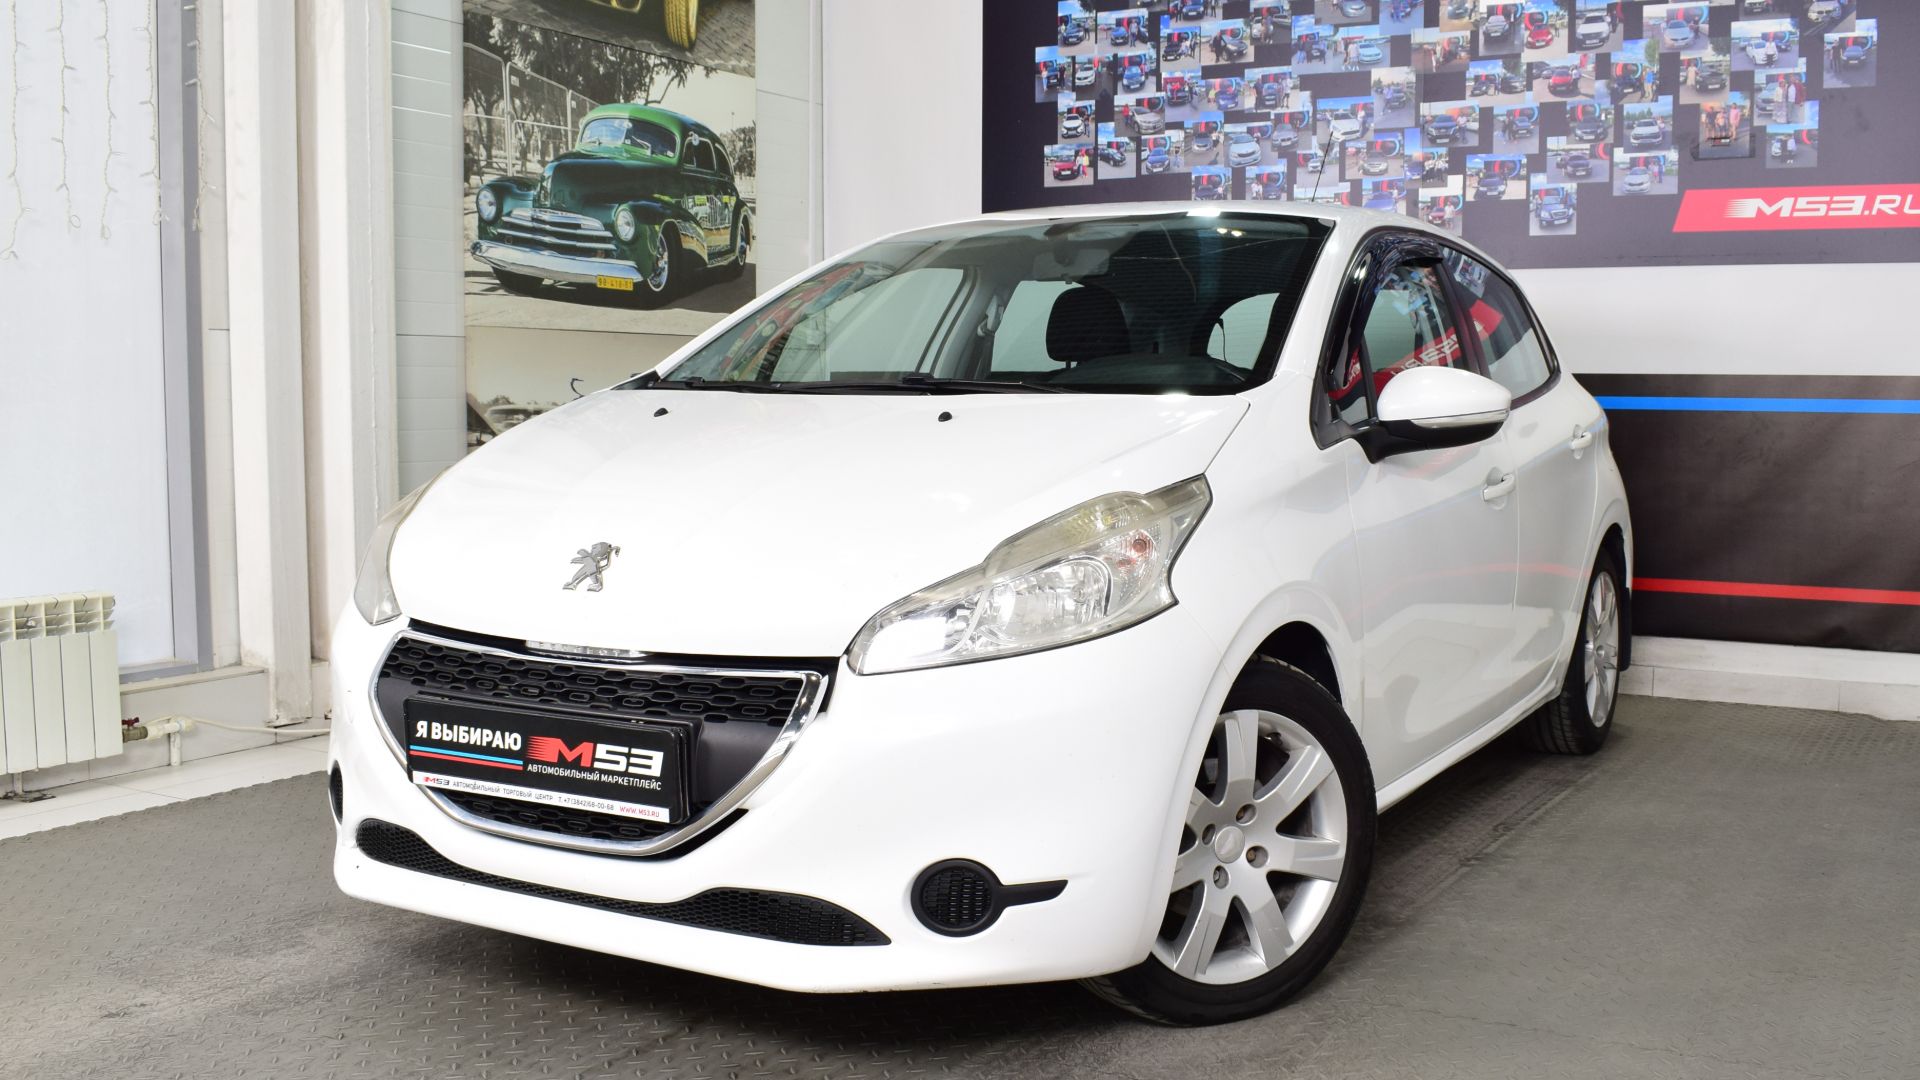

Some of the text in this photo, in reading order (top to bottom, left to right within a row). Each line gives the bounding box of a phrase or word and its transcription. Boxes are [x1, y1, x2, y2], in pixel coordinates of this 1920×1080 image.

[415, 720, 522, 751] Я ВЫБИРАЮ
[526, 735, 664, 777] M53
[423, 776, 450, 786] M53
[452, 780, 500, 793] АВТОМОБИЛЬНЫЙ
[502, 788, 533, 798] ТОРГОВЫЙ
[534, 793, 554, 801] ЦЕНТР
[527, 763, 662, 791] АВТОМОБИЛЬНЫЙ МАРКЕТПЛЕЙС
